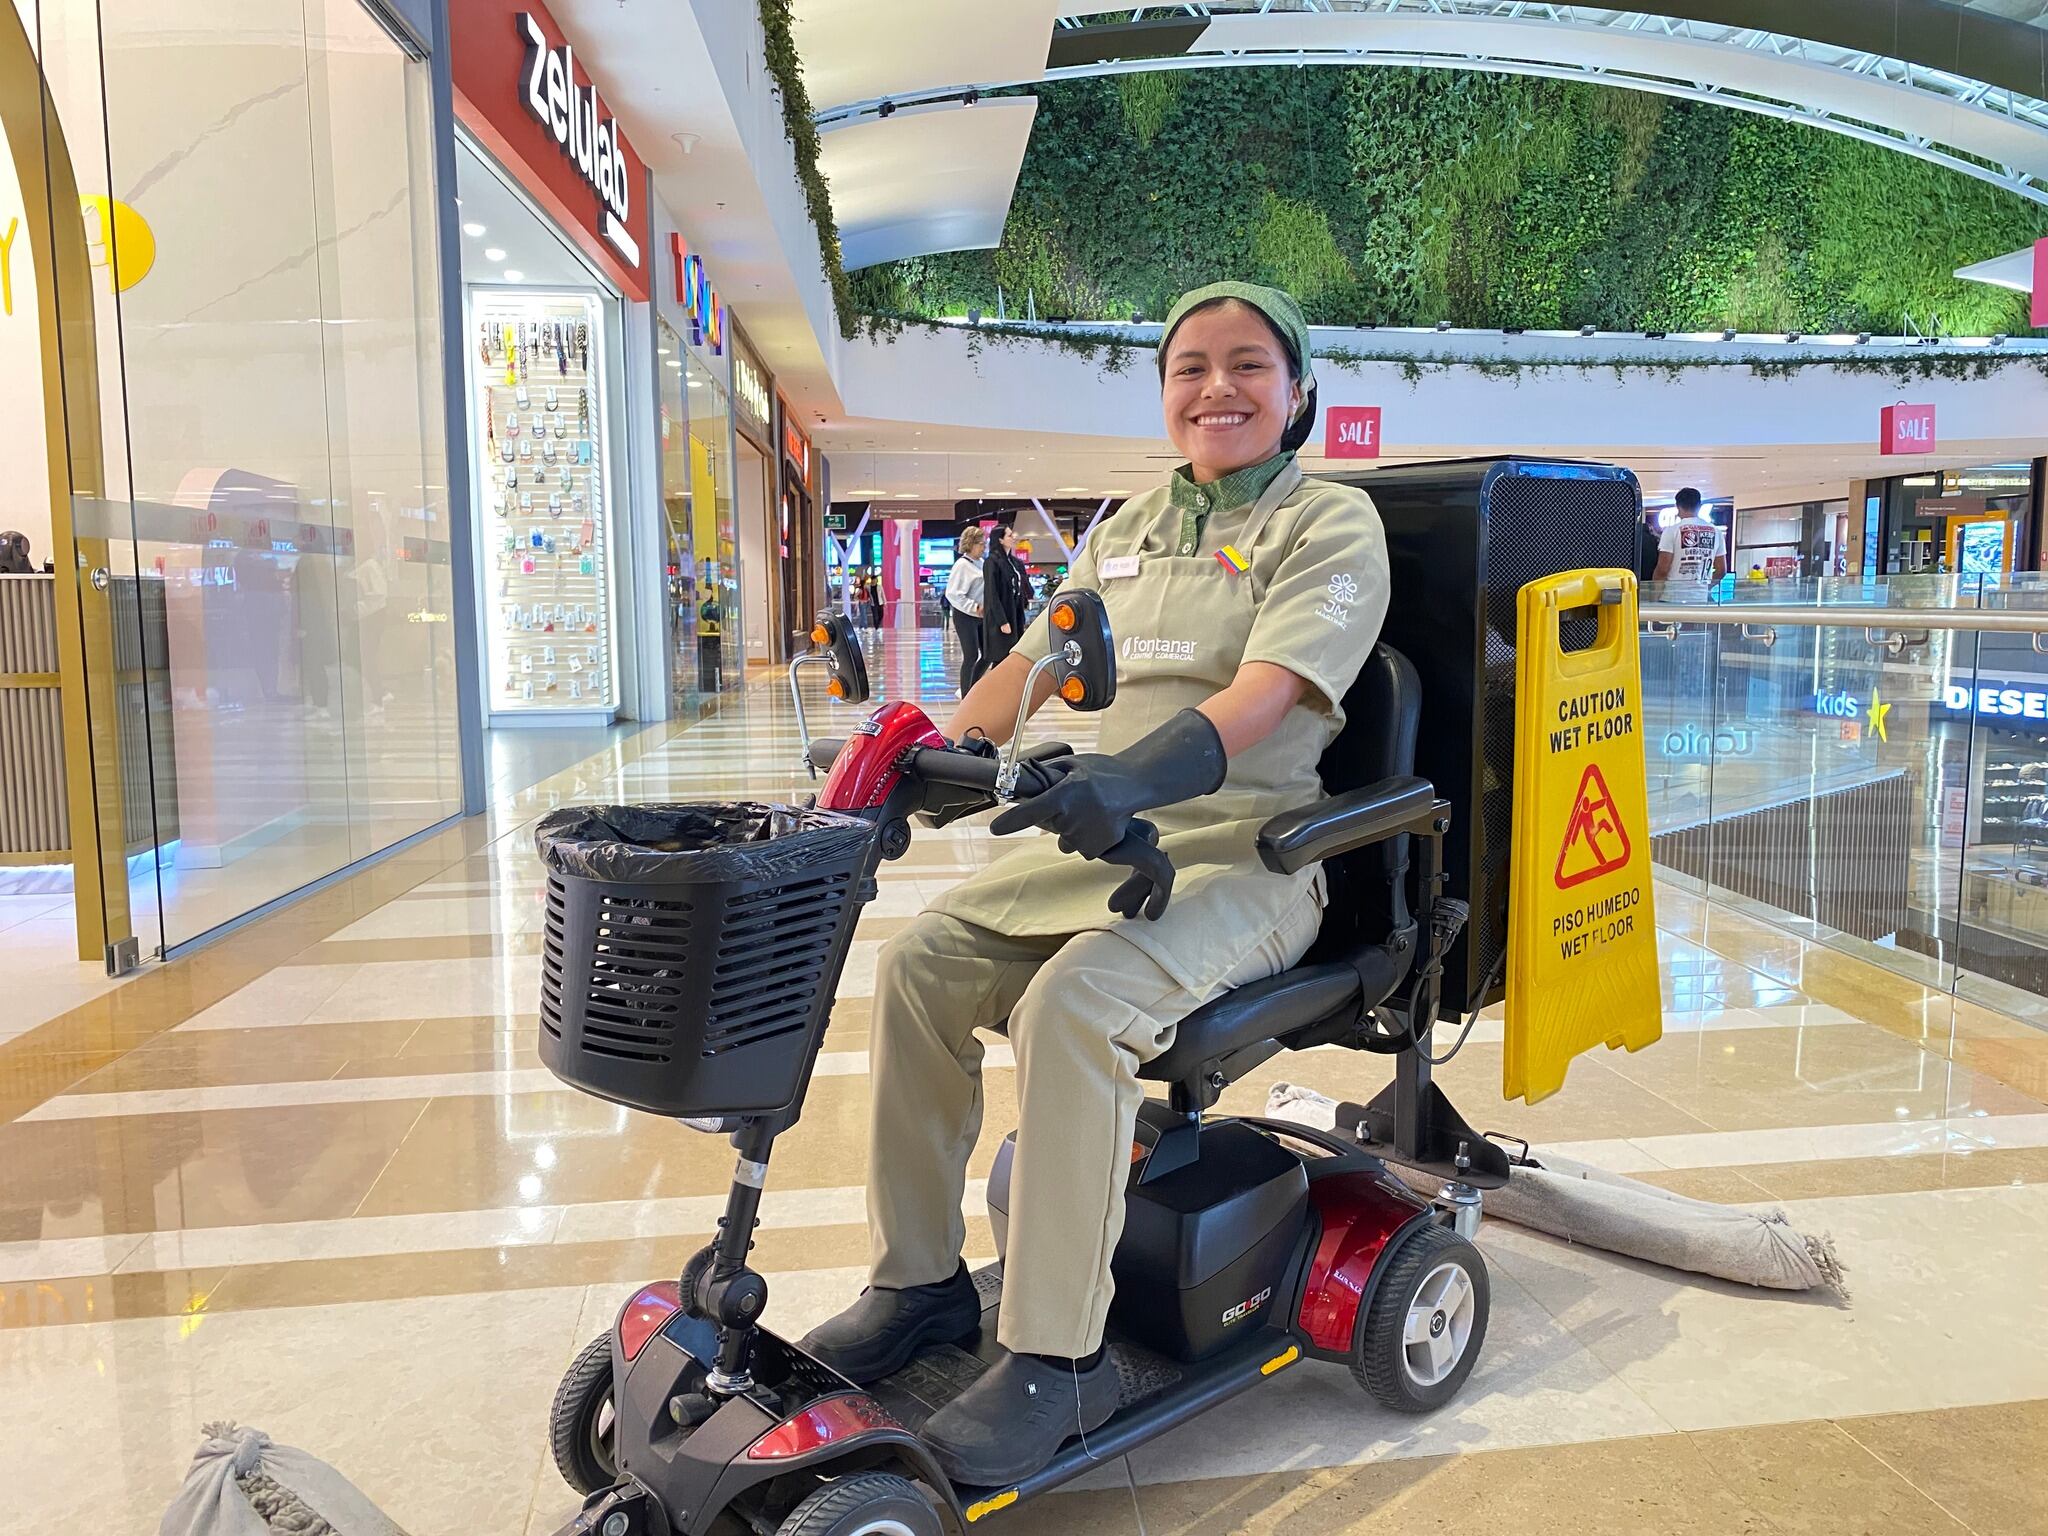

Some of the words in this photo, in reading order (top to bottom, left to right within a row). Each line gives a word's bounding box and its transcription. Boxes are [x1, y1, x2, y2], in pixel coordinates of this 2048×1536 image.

[1338, 420, 1375, 446] SALE
[1898, 417, 1930, 441] SALE
[1323, 599, 1348, 621] JM
[1133, 636, 1198, 654] fontanar
[1155, 652, 1195, 661] COMERCIAL
[1558, 687, 1625, 722] CAUTION
[1816, 688, 1859, 718] kids
[1943, 685, 2048, 719] DIESE
[1549, 725, 1582, 754] WET
[1587, 713, 1633, 744] FLOOR
[1553, 909, 1584, 937] PISO
[1587, 887, 1640, 924] HUMEDO
[1561, 933, 1589, 960] WET
[1592, 915, 1634, 943] FLOOR
